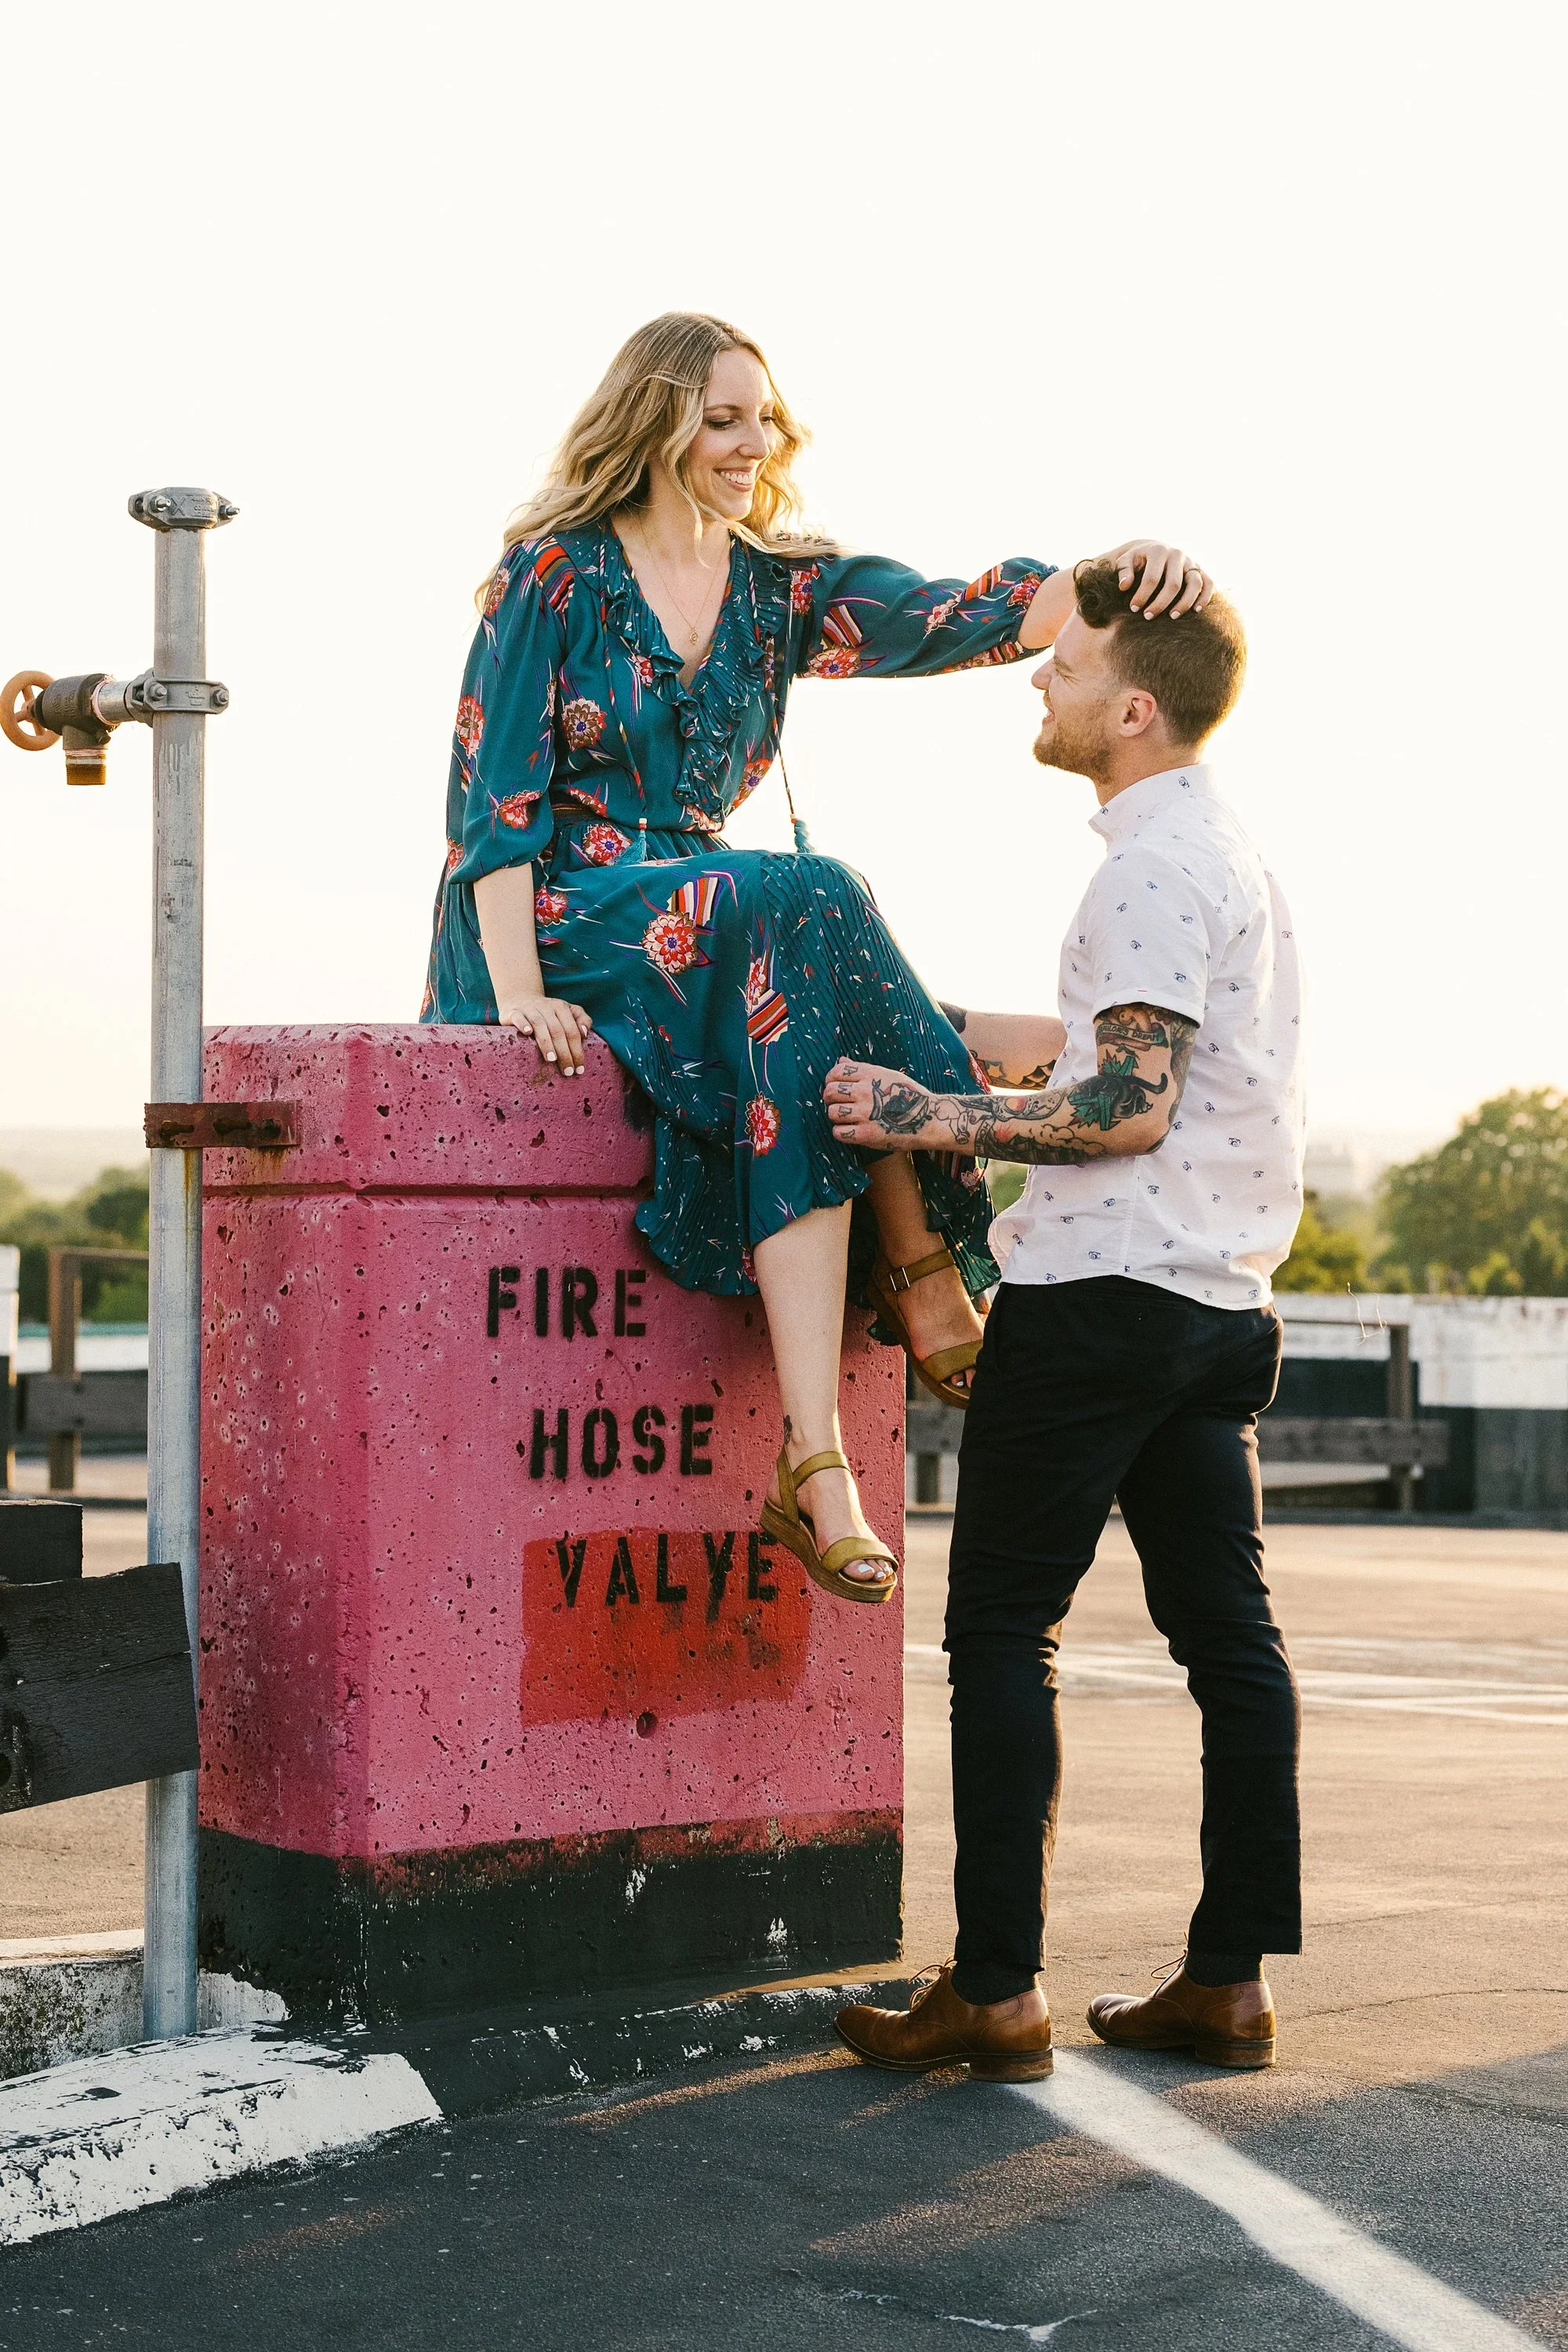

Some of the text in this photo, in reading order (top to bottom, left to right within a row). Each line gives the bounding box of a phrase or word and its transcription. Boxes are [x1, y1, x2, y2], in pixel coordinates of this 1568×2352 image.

[486, 1266, 648, 1338] FIRE
[528, 1404, 714, 1479] HOSE
[556, 1530, 779, 1617] VALVE
